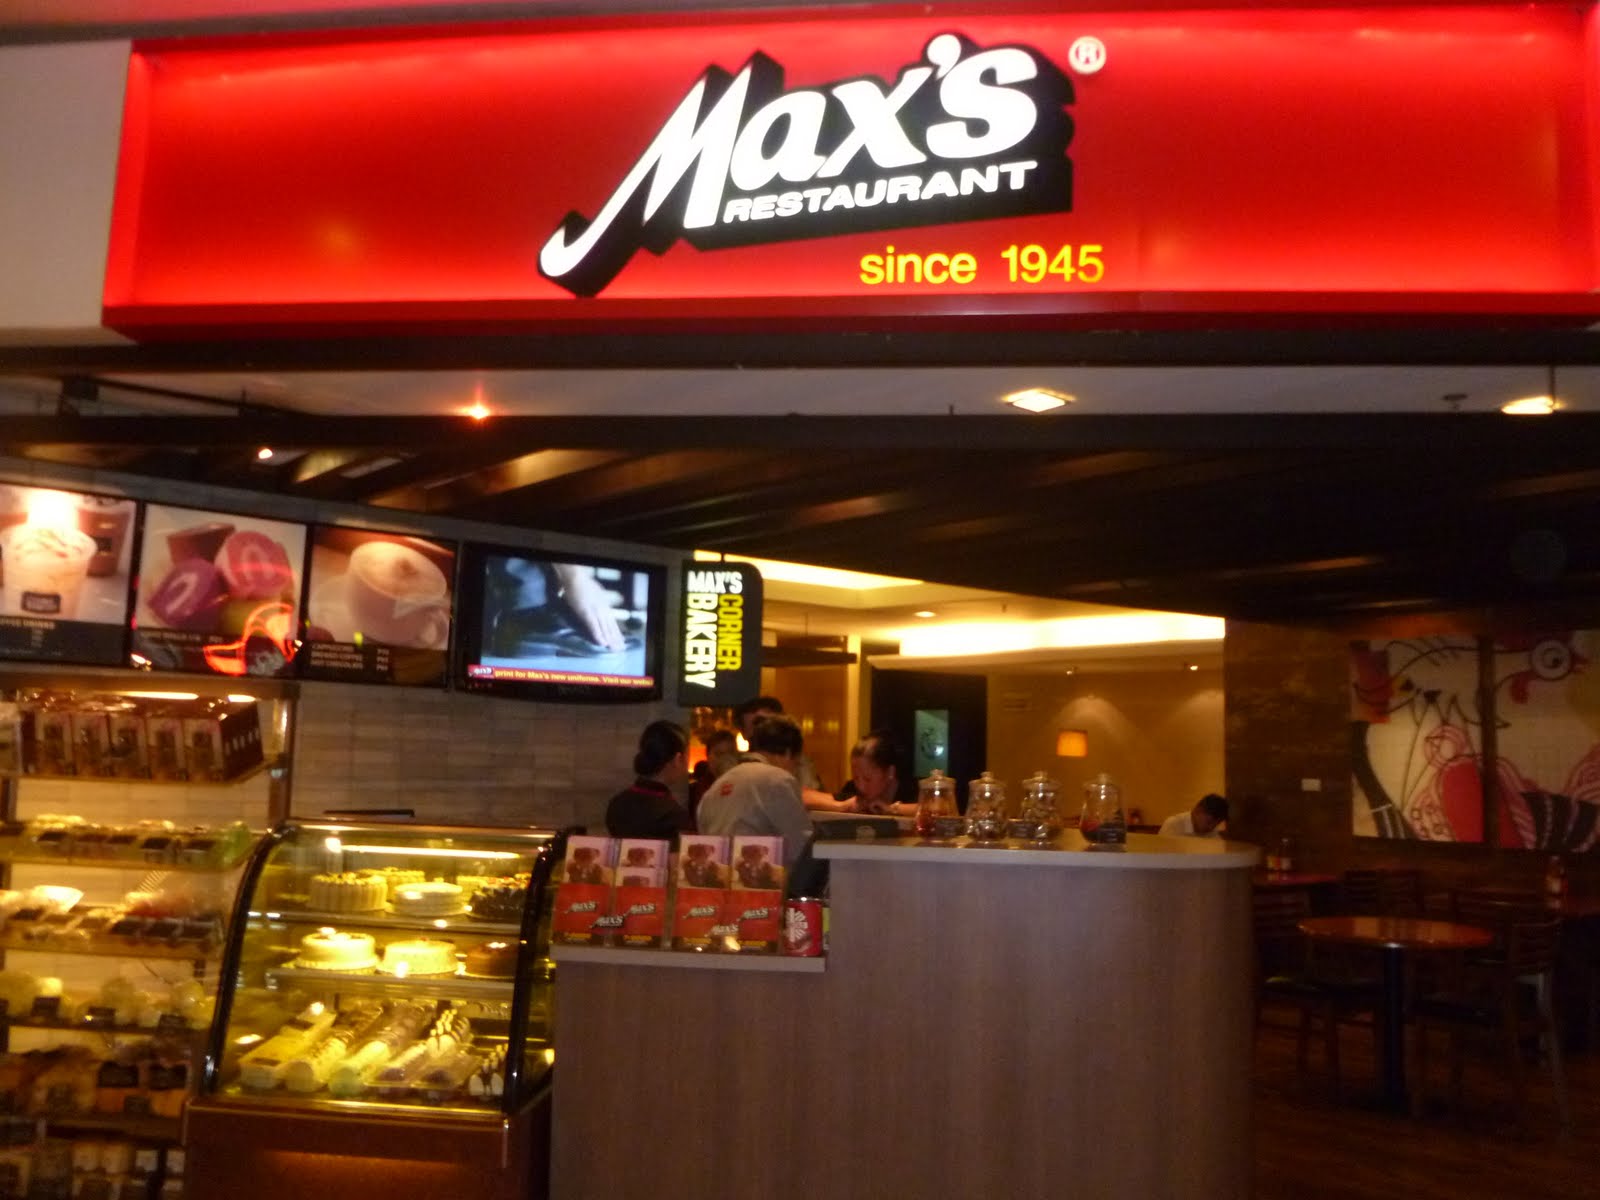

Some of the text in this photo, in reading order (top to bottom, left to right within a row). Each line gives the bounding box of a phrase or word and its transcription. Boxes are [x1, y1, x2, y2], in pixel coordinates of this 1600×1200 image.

[538, 34, 1038, 278] Max's
[723, 161, 1038, 225] RESTAURANT
[860, 244, 1105, 284] since 1945
[687, 570, 743, 594] MAX'S
[685, 593, 718, 688] BAKERY
[717, 594, 744, 670] CORNER
